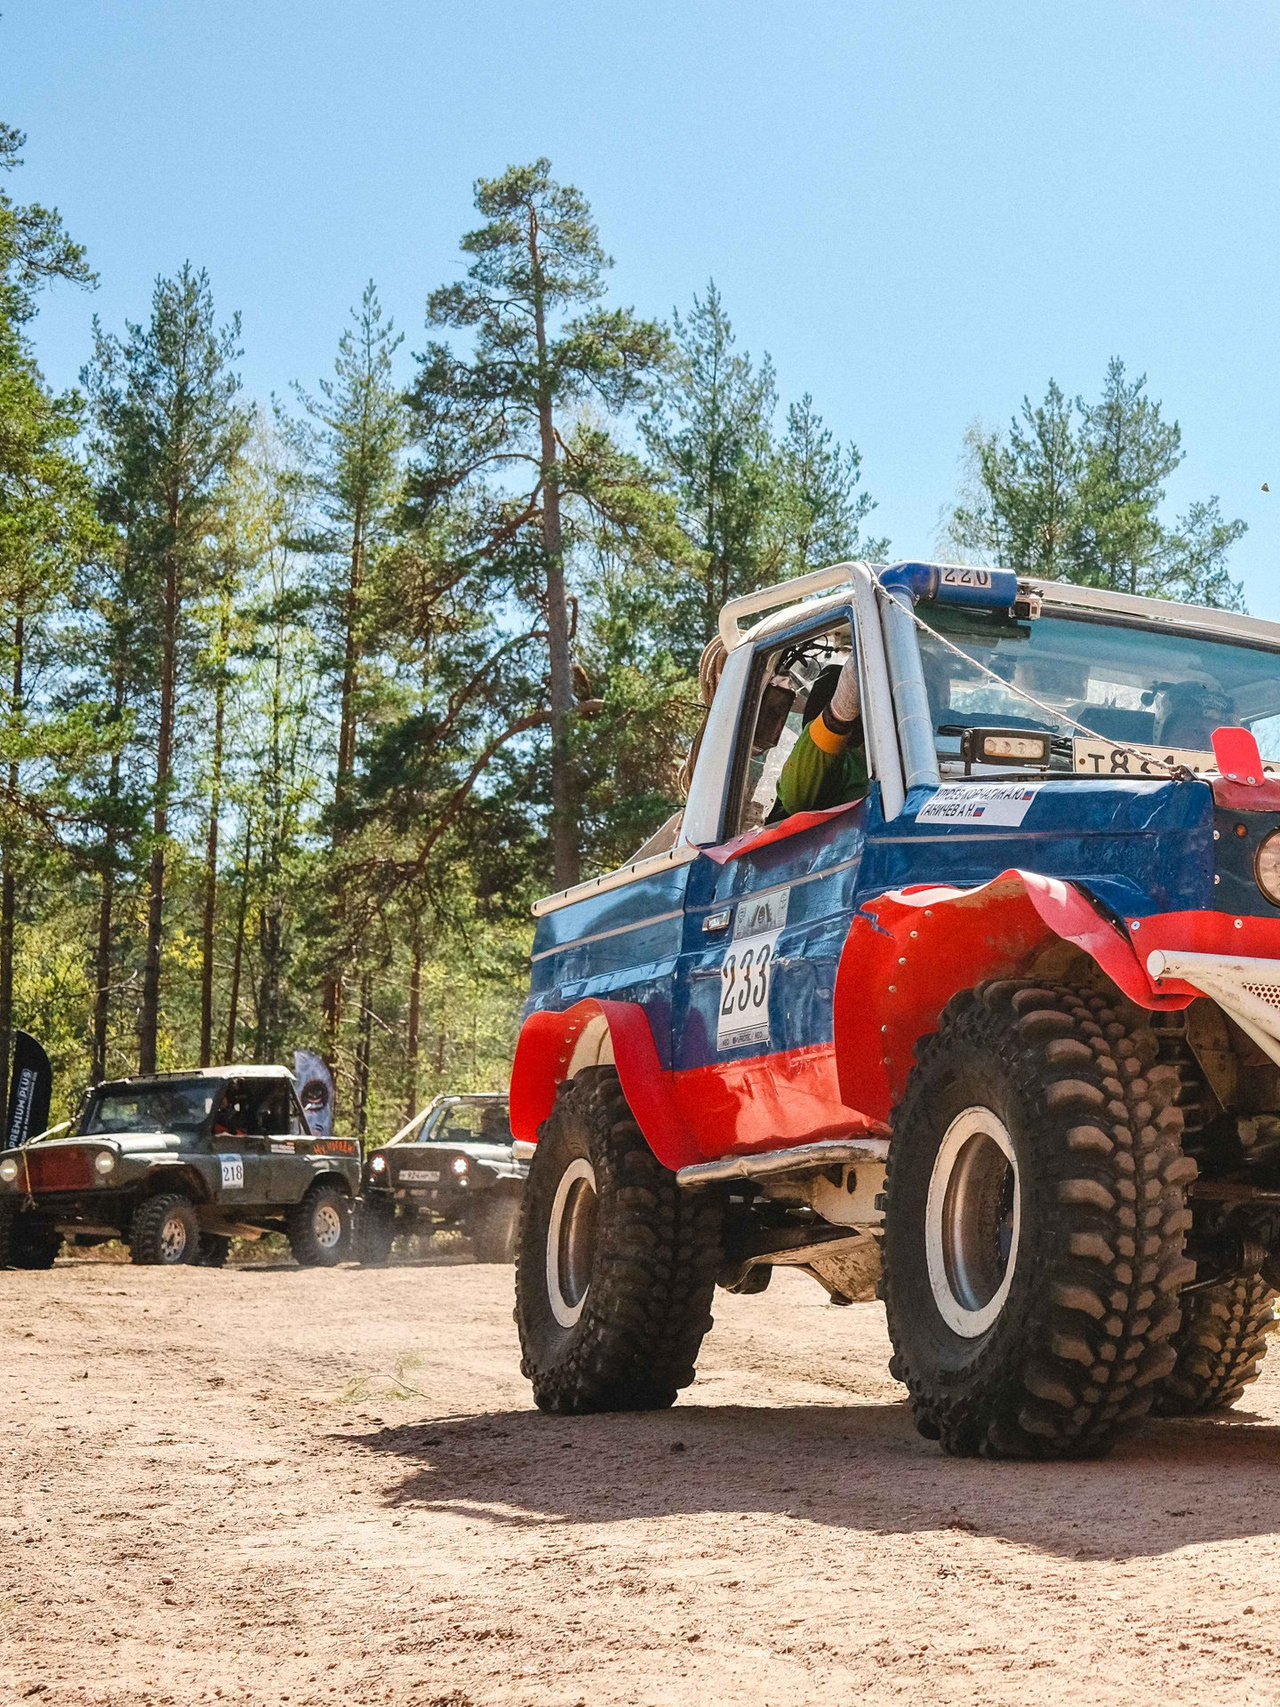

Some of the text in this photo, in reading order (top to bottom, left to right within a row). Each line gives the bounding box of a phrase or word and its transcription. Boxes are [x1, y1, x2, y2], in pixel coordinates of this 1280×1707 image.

[944, 567, 989, 586] 220
[722, 944, 770, 1016] 233
[9, 1100, 25, 1148] PREMIUM
[20, 1071, 32, 1098] PLUS
[223, 1165, 242, 1181] 218
